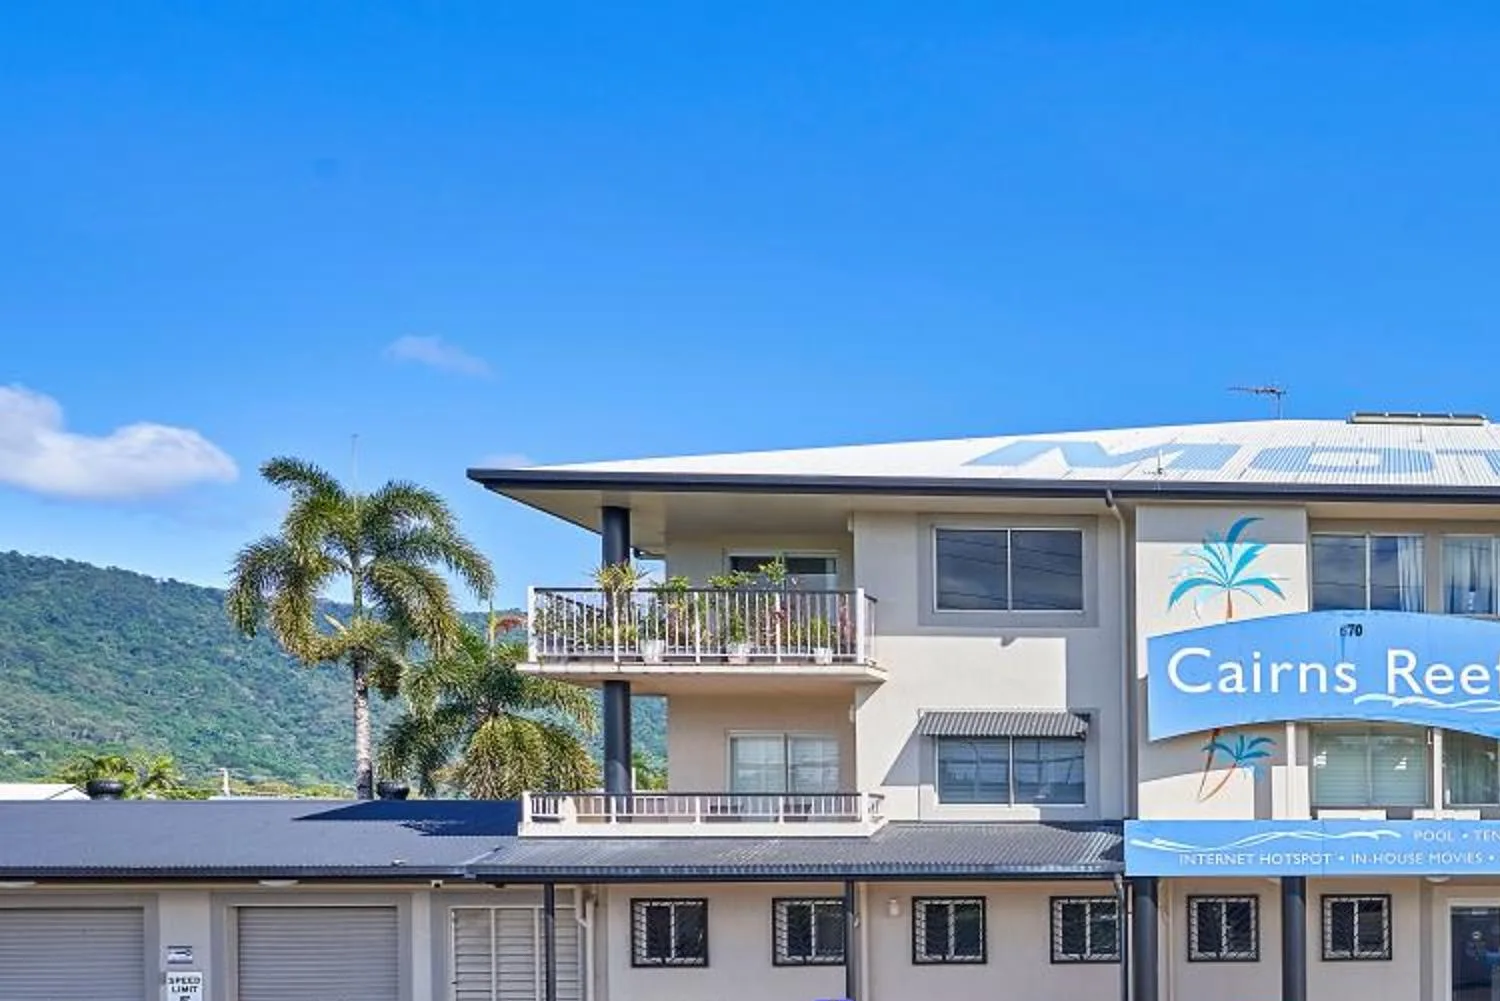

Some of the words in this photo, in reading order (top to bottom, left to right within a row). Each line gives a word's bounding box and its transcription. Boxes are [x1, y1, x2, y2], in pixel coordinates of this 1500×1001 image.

[1340, 624, 1363, 637] 670
[1167, 647, 1358, 694] Cairns
[1413, 830, 1455, 842] POOL
[1179, 853, 1256, 866] INTERNET
[1259, 853, 1332, 865] HOTSPOT
[1351, 852, 1423, 865] IN-HOUSE
[1428, 852, 1483, 864] MOVIES
[168, 976, 201, 985] SPEED
